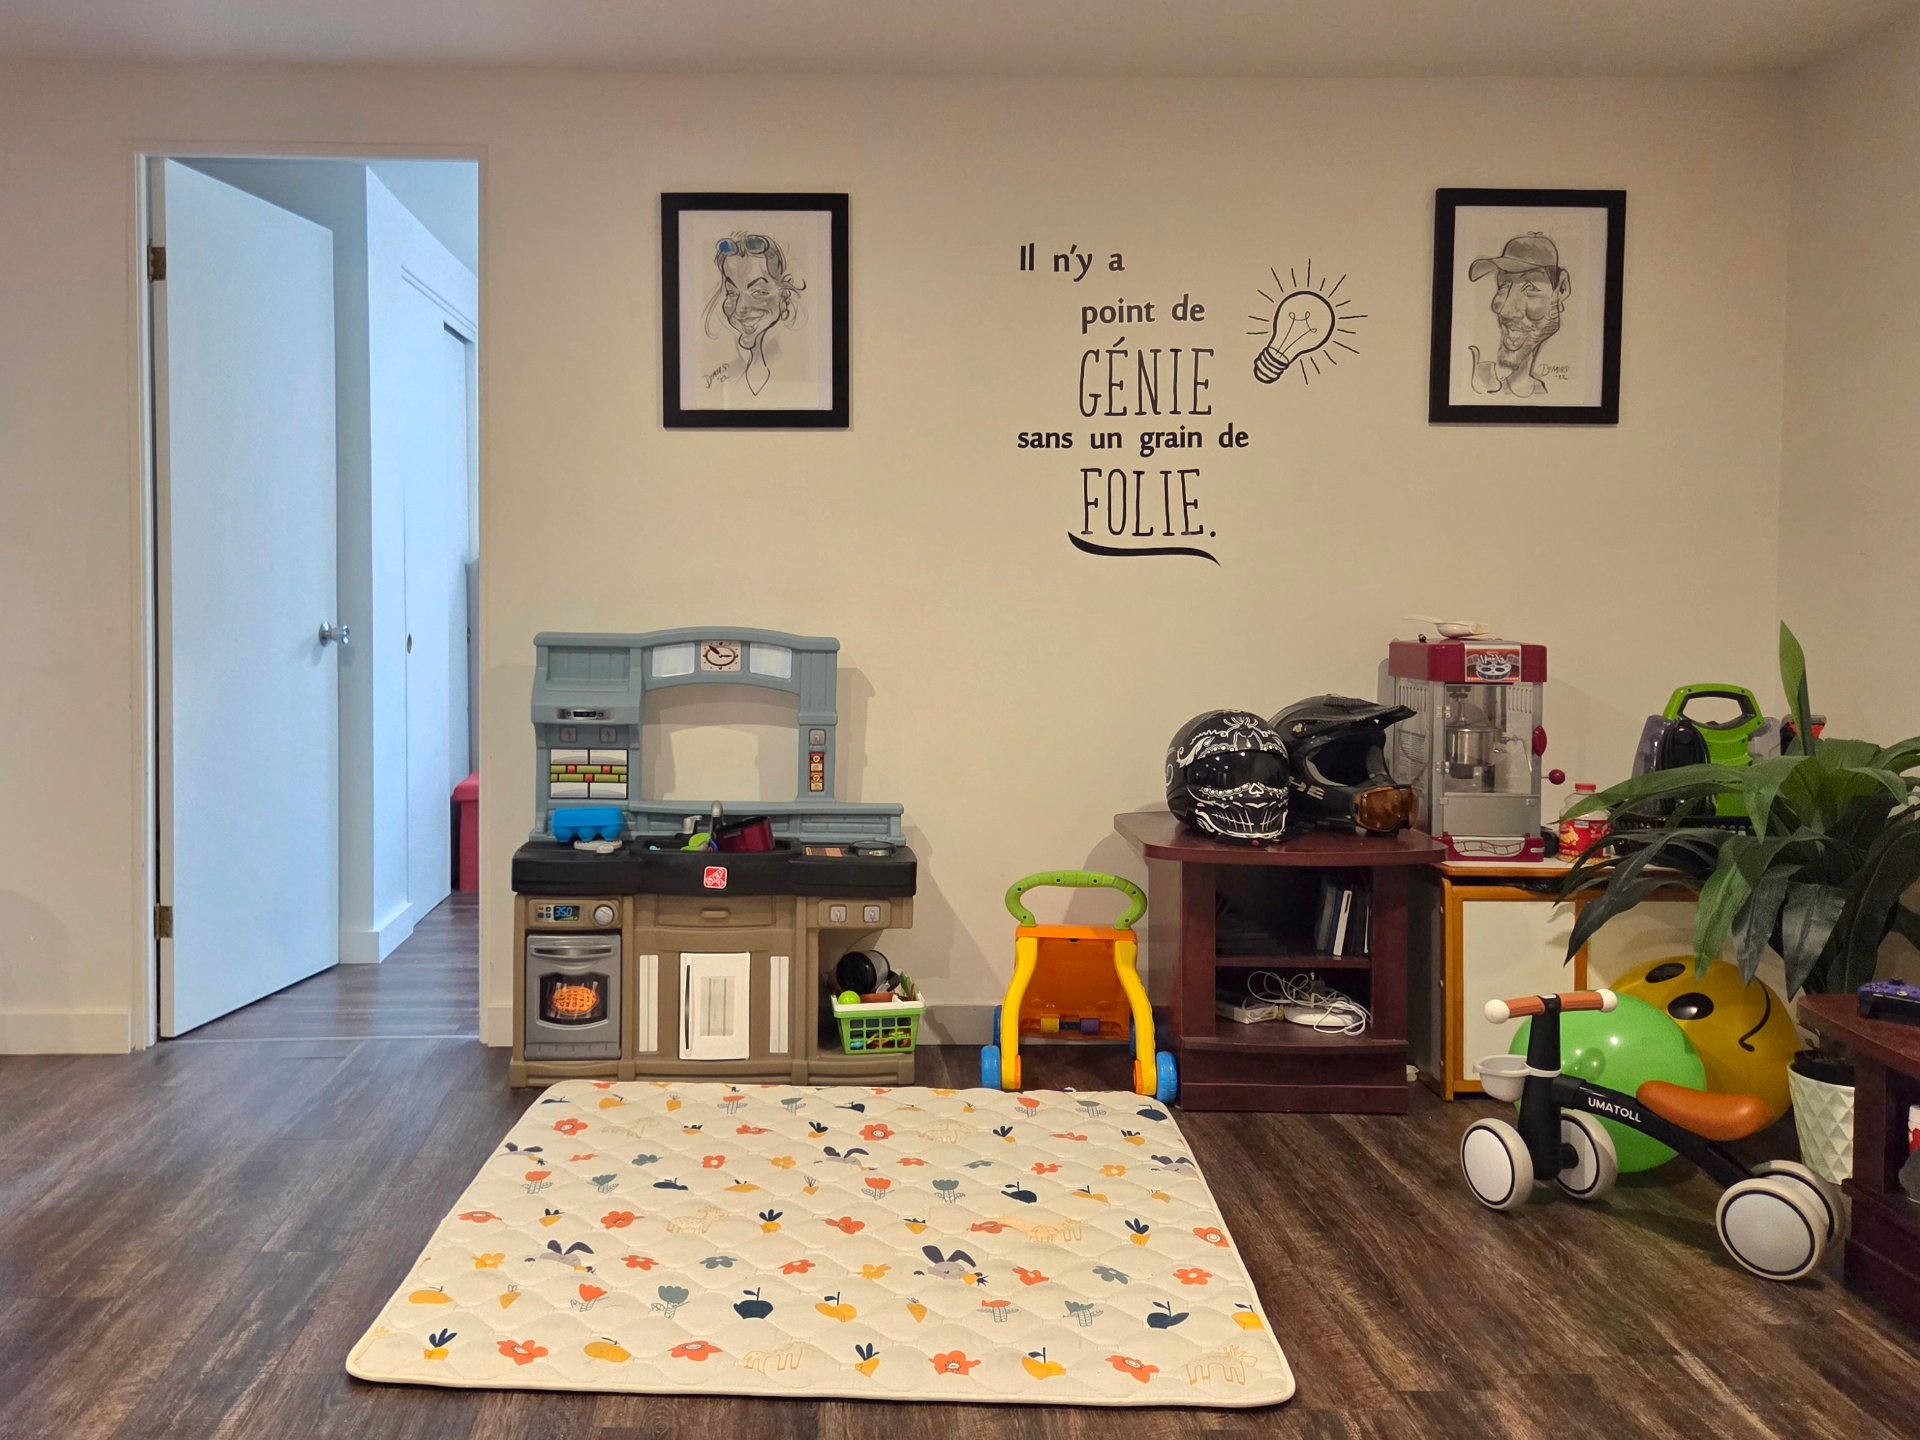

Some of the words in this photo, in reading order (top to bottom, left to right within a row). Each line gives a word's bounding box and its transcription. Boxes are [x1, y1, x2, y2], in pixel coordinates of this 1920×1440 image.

[1019, 243, 1035, 271] Il
[1053, 244, 1093, 282] n'y
[1108, 253, 1125, 271] a
[1081, 297, 1155, 334] point
[1171, 294, 1205, 322] de
[1079, 336, 1215, 418] GÉNIE
[1016, 431, 1074, 449] sans
[1090, 432, 1122, 449] un
[1139, 425, 1203, 458] grain
[1218, 422, 1250, 449] de
[1080, 468, 1217, 538] FOLIE.
[555, 906, 573, 917] 350
[1588, 1096, 1642, 1123] UMATOLL
